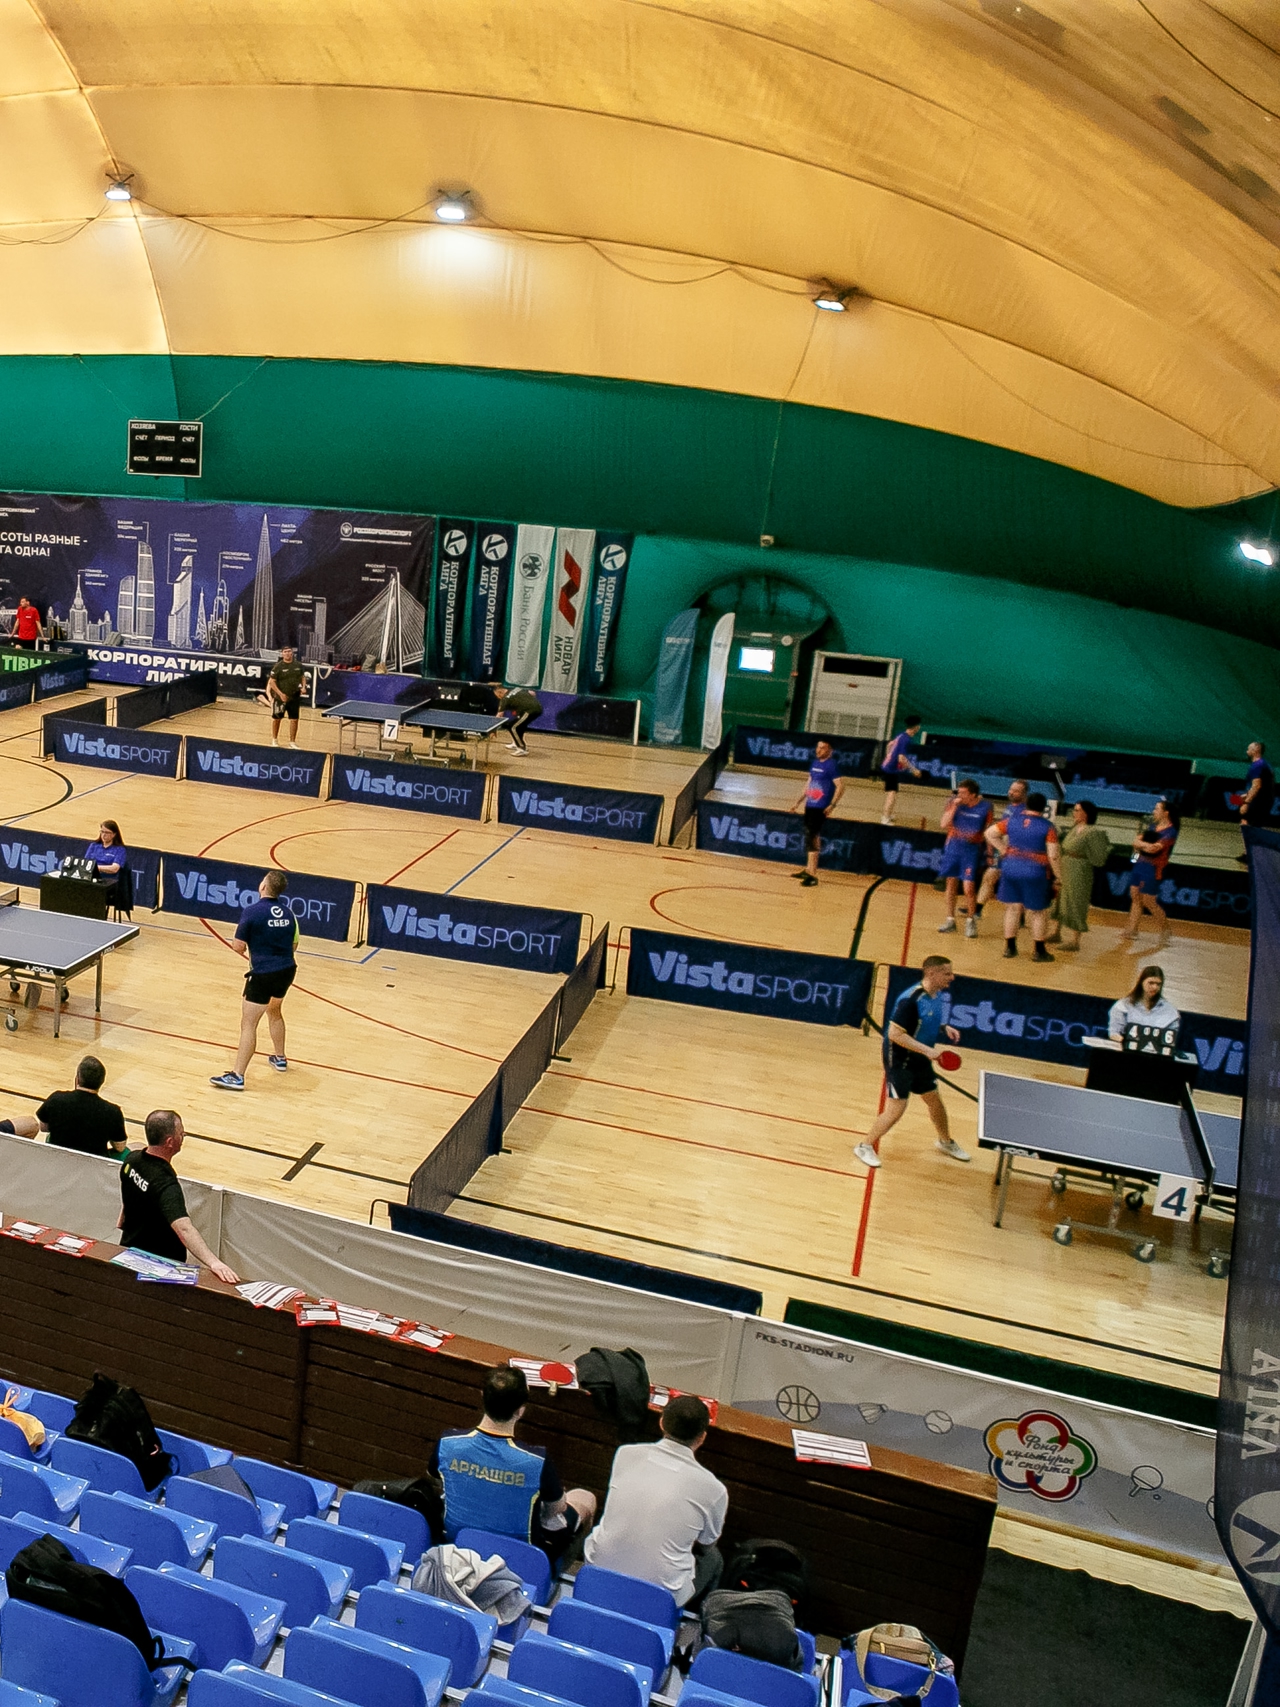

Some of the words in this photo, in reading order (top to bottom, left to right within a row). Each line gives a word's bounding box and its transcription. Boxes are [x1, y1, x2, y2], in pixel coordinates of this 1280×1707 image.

[14, 545, 50, 557] ОДНА!
[35, 534, 81, 546] РАЗНЫЕ
[439, 560, 451, 591] ЛИГА
[478, 565, 490, 596] ЛИГА
[596, 575, 607, 605] ЛИГА
[443, 560, 459, 659] КОРПОРАТИВНАЯ
[482, 565, 500, 665] КОРПОРАТИВНАЯ
[520, 586, 535, 616] Банк
[517, 618, 531, 661] России
[594, 576, 617, 673] КОРПОРАТИВНАЯ
[553, 635, 564, 663] ЛИГА
[561, 637, 574, 675] НОВАЯ
[386, 724, 397, 738] 7
[63, 732, 172, 766] VistaSPORT
[196, 749, 314, 785] VistaSPORT
[345, 767, 472, 806] VistaSPORT
[510, 789, 648, 830] VistaSPORT
[710, 814, 856, 859] VistaSORT
[85, 860, 93, 871] 8
[176, 870, 337, 923] VistaPORT
[267, 917, 291, 929] СБЕР
[382, 903, 562, 957] VistaSPORT
[30, 965, 55, 976] JOOLA
[648, 949, 851, 1010] VistaSPORT
[1164, 1030, 1174, 1044] 6
[129, 1168, 149, 1192] РСХБ
[1161, 1186, 1188, 1217] 4
[755, 1331, 855, 1363] FKS-STADION.RU
[1004, 1449, 1075, 1468] культуры
[1025, 1434, 1059, 1455] Фонд
[1017, 1461, 1071, 1475] спорта
